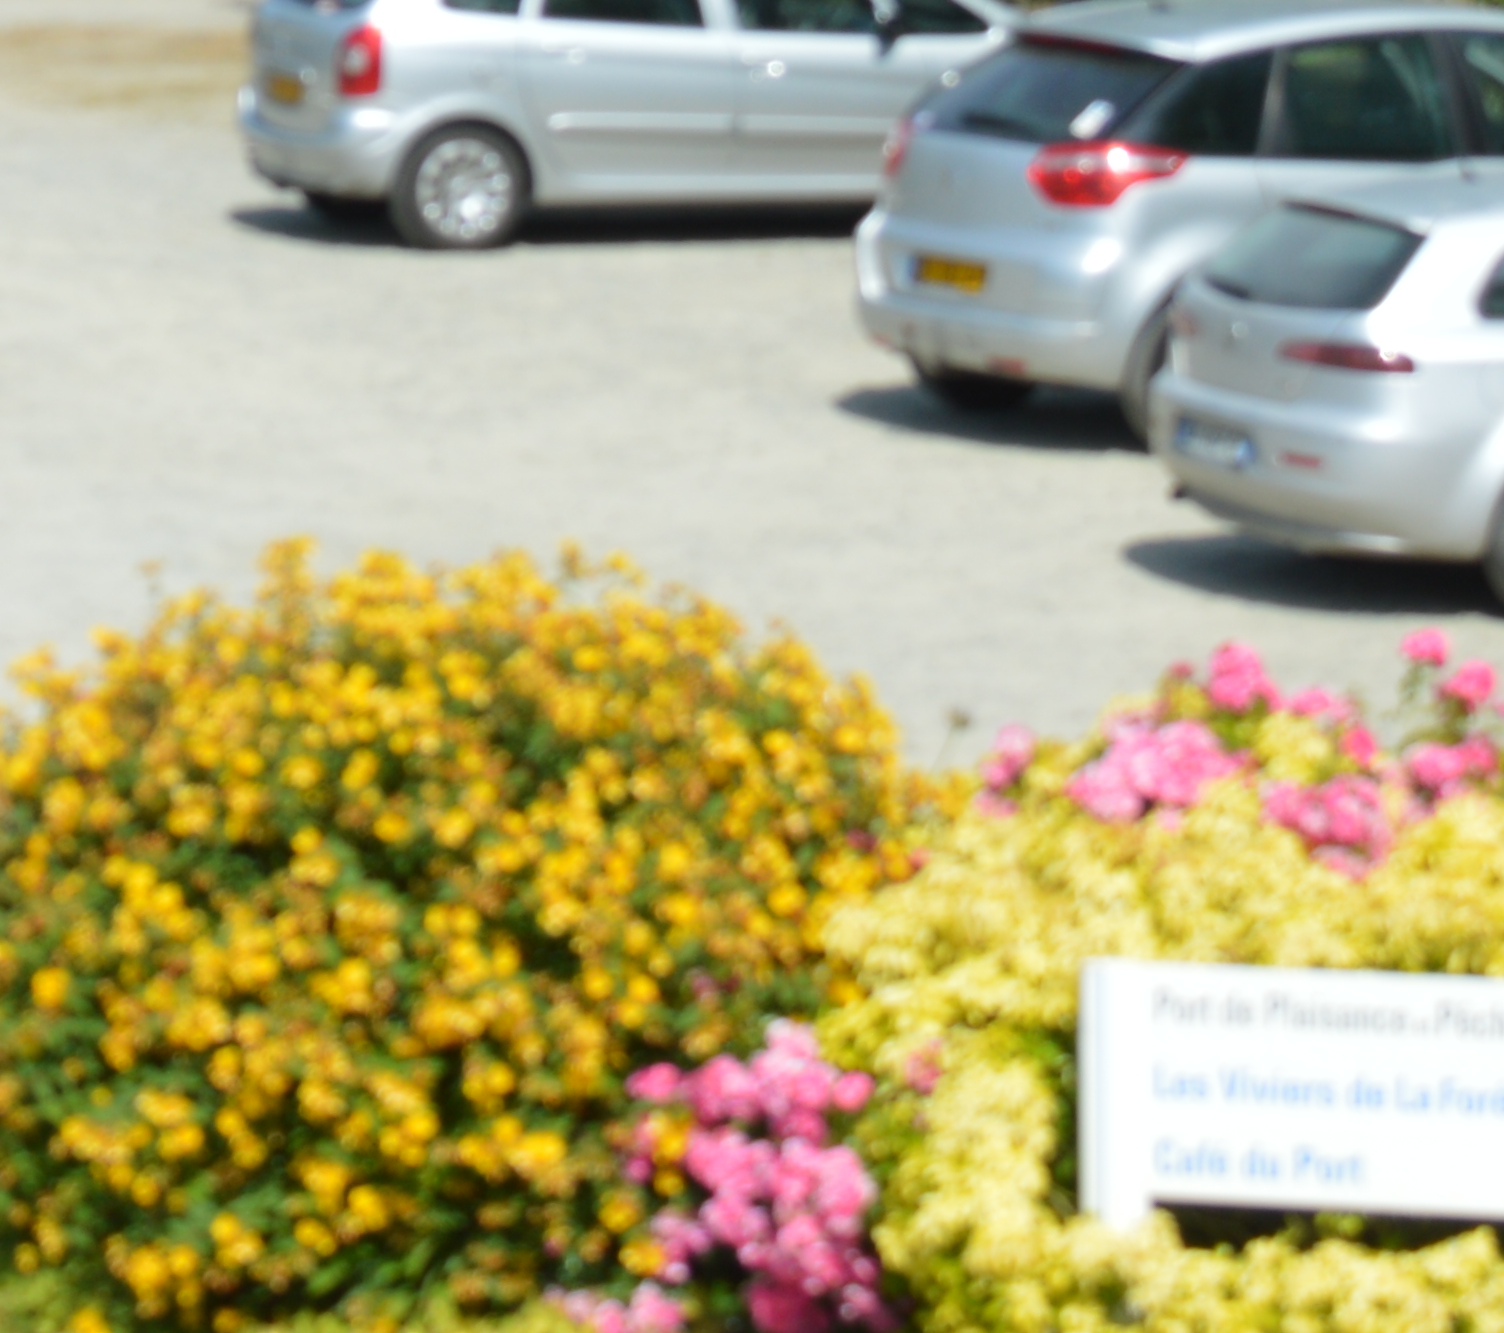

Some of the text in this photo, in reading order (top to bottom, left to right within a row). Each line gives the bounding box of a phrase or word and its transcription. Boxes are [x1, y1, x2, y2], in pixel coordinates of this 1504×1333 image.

[1152, 984, 1210, 1027] Port
[1223, 993, 1254, 1028] de
[1153, 1060, 1208, 1102] Les
[1217, 1062, 1334, 1106] Viviers
[1346, 1073, 1386, 1109] de
[1394, 1073, 1432, 1112] La
[1240, 1144, 1281, 1182] du
[1292, 1144, 1367, 1187] Port
